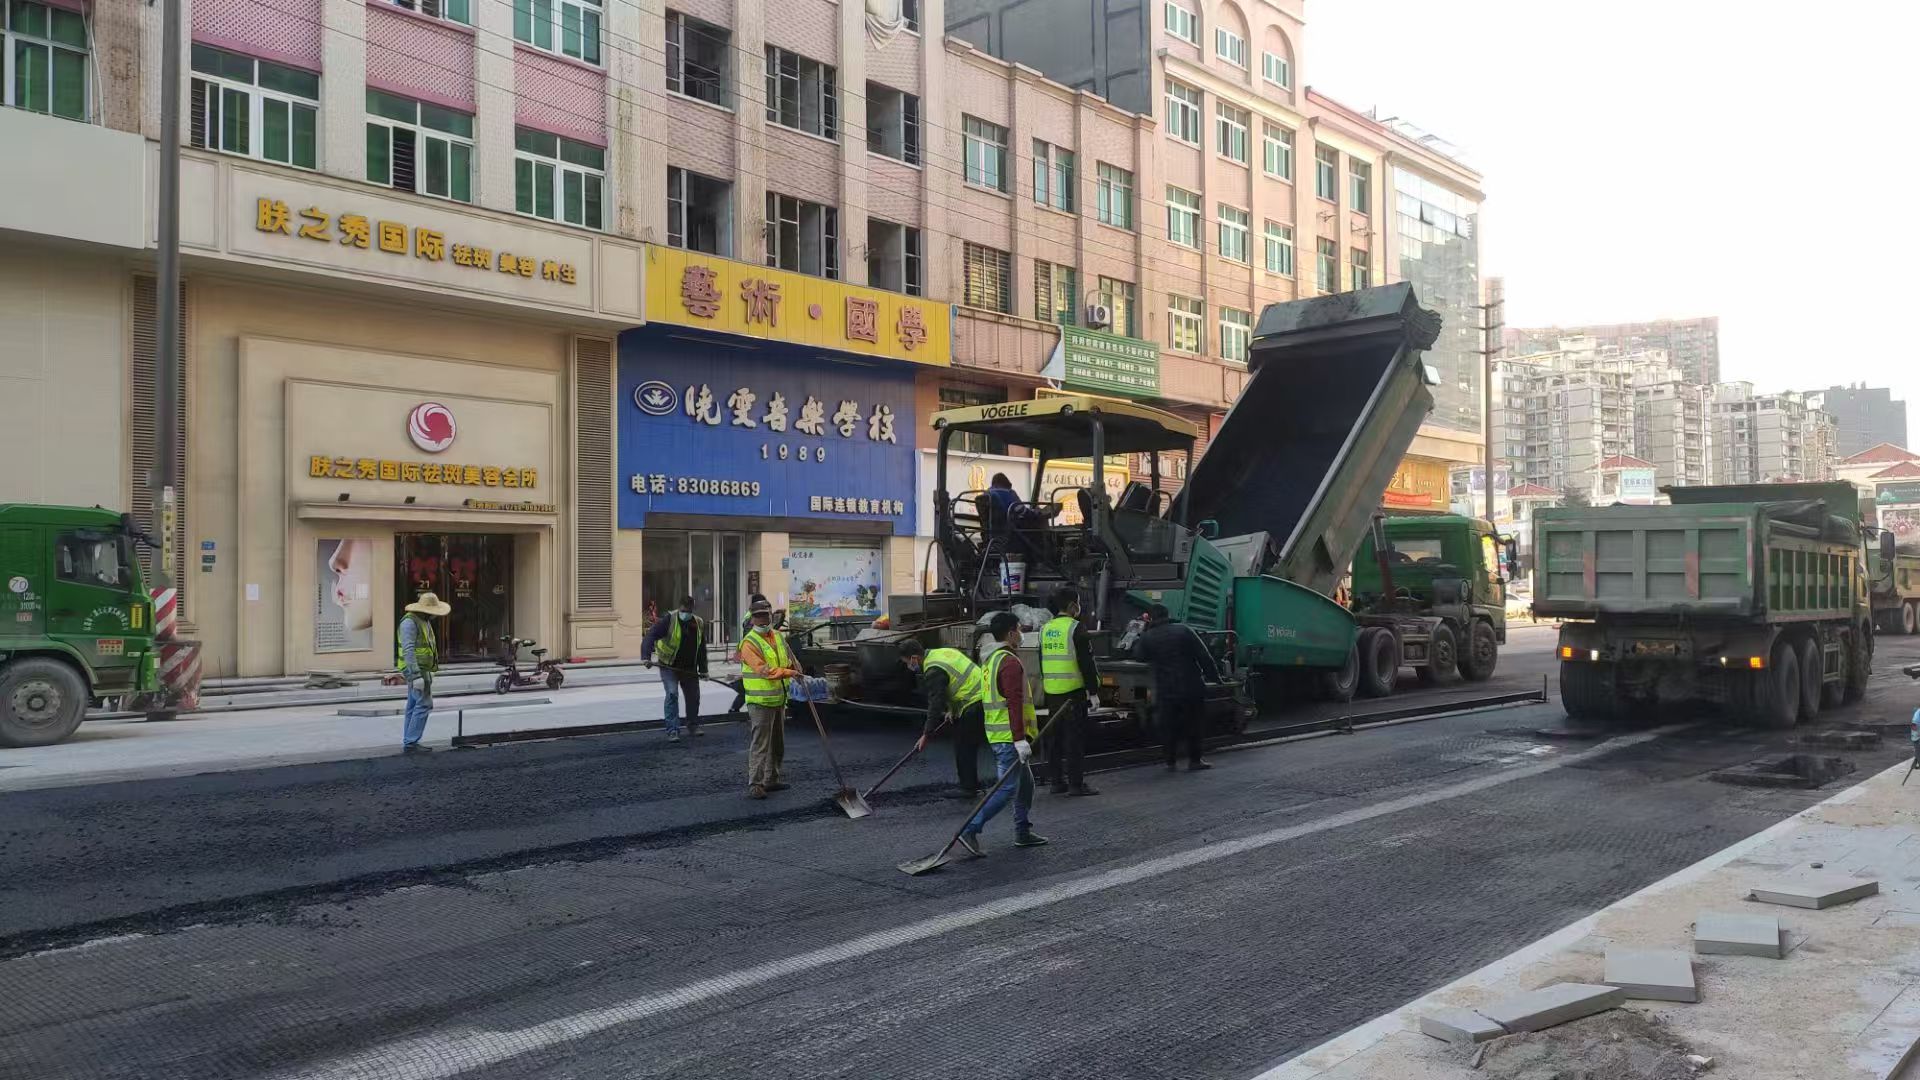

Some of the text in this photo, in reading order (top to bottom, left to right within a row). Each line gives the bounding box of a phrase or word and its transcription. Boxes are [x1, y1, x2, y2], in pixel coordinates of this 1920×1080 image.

[256, 198, 446, 261] 肤之秀国际
[498, 252, 537, 277] 美容
[542, 260, 577, 285] 养生
[309, 455, 537, 489] 肤之秀国际祛斑美容会所
[810, 495, 904, 516] 国际连锁教育机构
